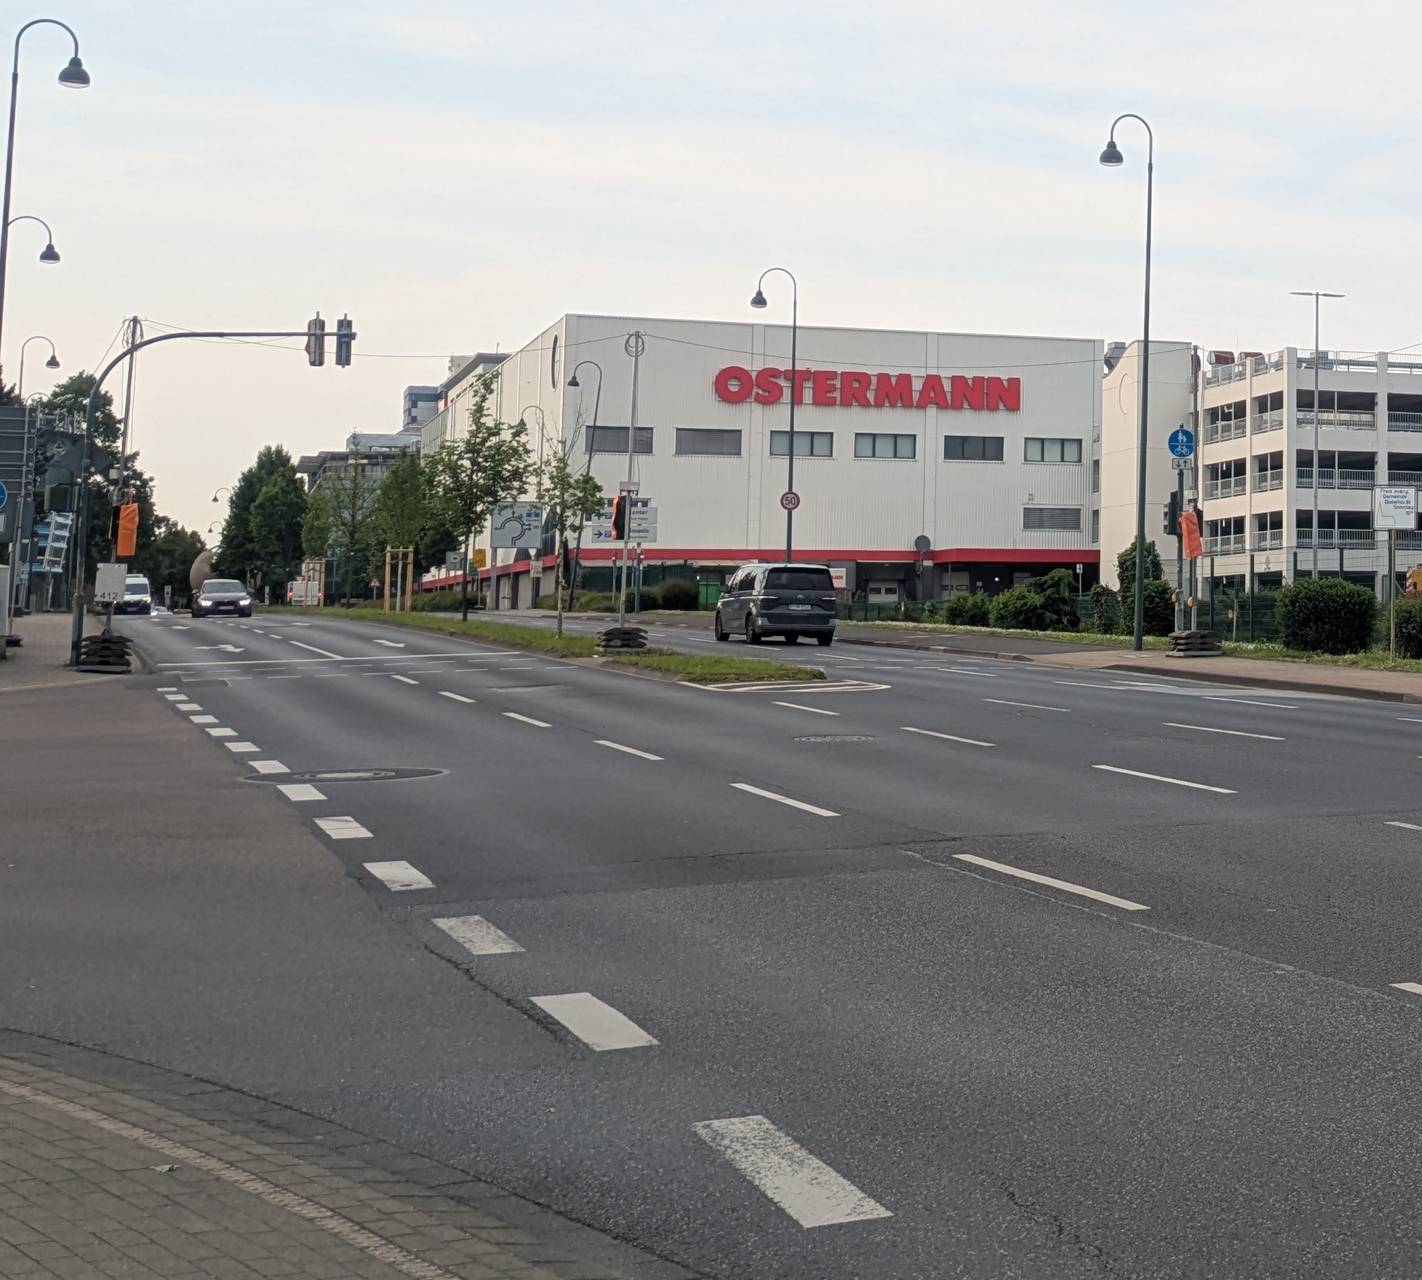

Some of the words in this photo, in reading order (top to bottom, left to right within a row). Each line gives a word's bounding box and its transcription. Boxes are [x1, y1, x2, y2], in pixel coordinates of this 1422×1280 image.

[714, 366, 1021, 411] OSTERMANN
[784, 497, 796, 506] 50
[100, 591, 119, 600] 412
